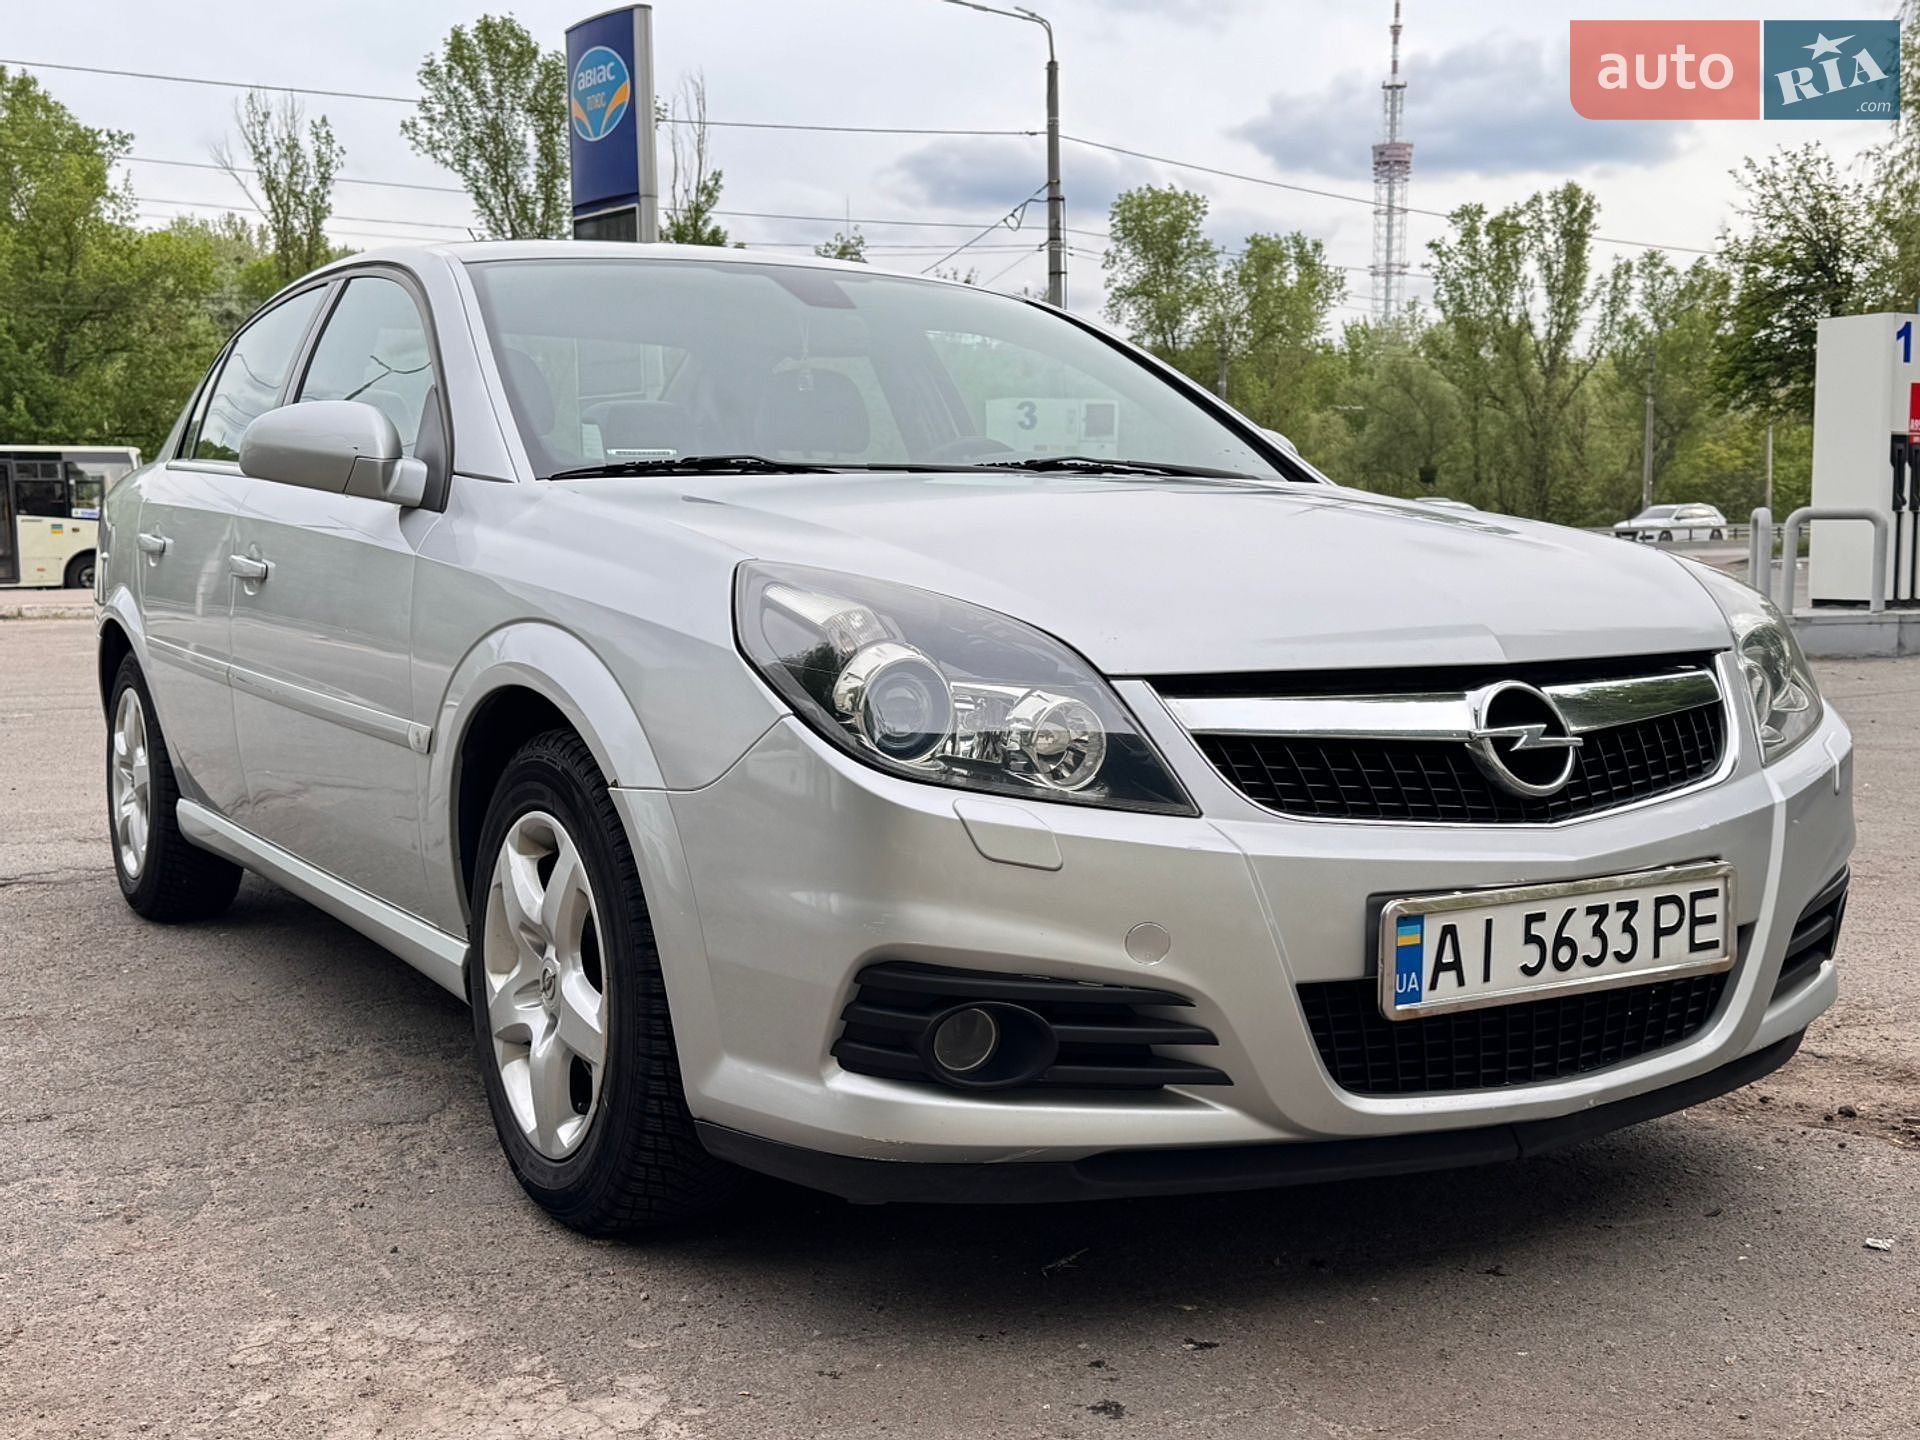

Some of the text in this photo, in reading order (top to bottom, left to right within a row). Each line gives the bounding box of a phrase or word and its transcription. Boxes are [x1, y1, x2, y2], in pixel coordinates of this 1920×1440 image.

[1896, 321, 1912, 363] 1
[1016, 401, 1038, 430] 3
[1428, 887, 1720, 991] AI 5633 PE
[1396, 972, 1420, 993] UA
